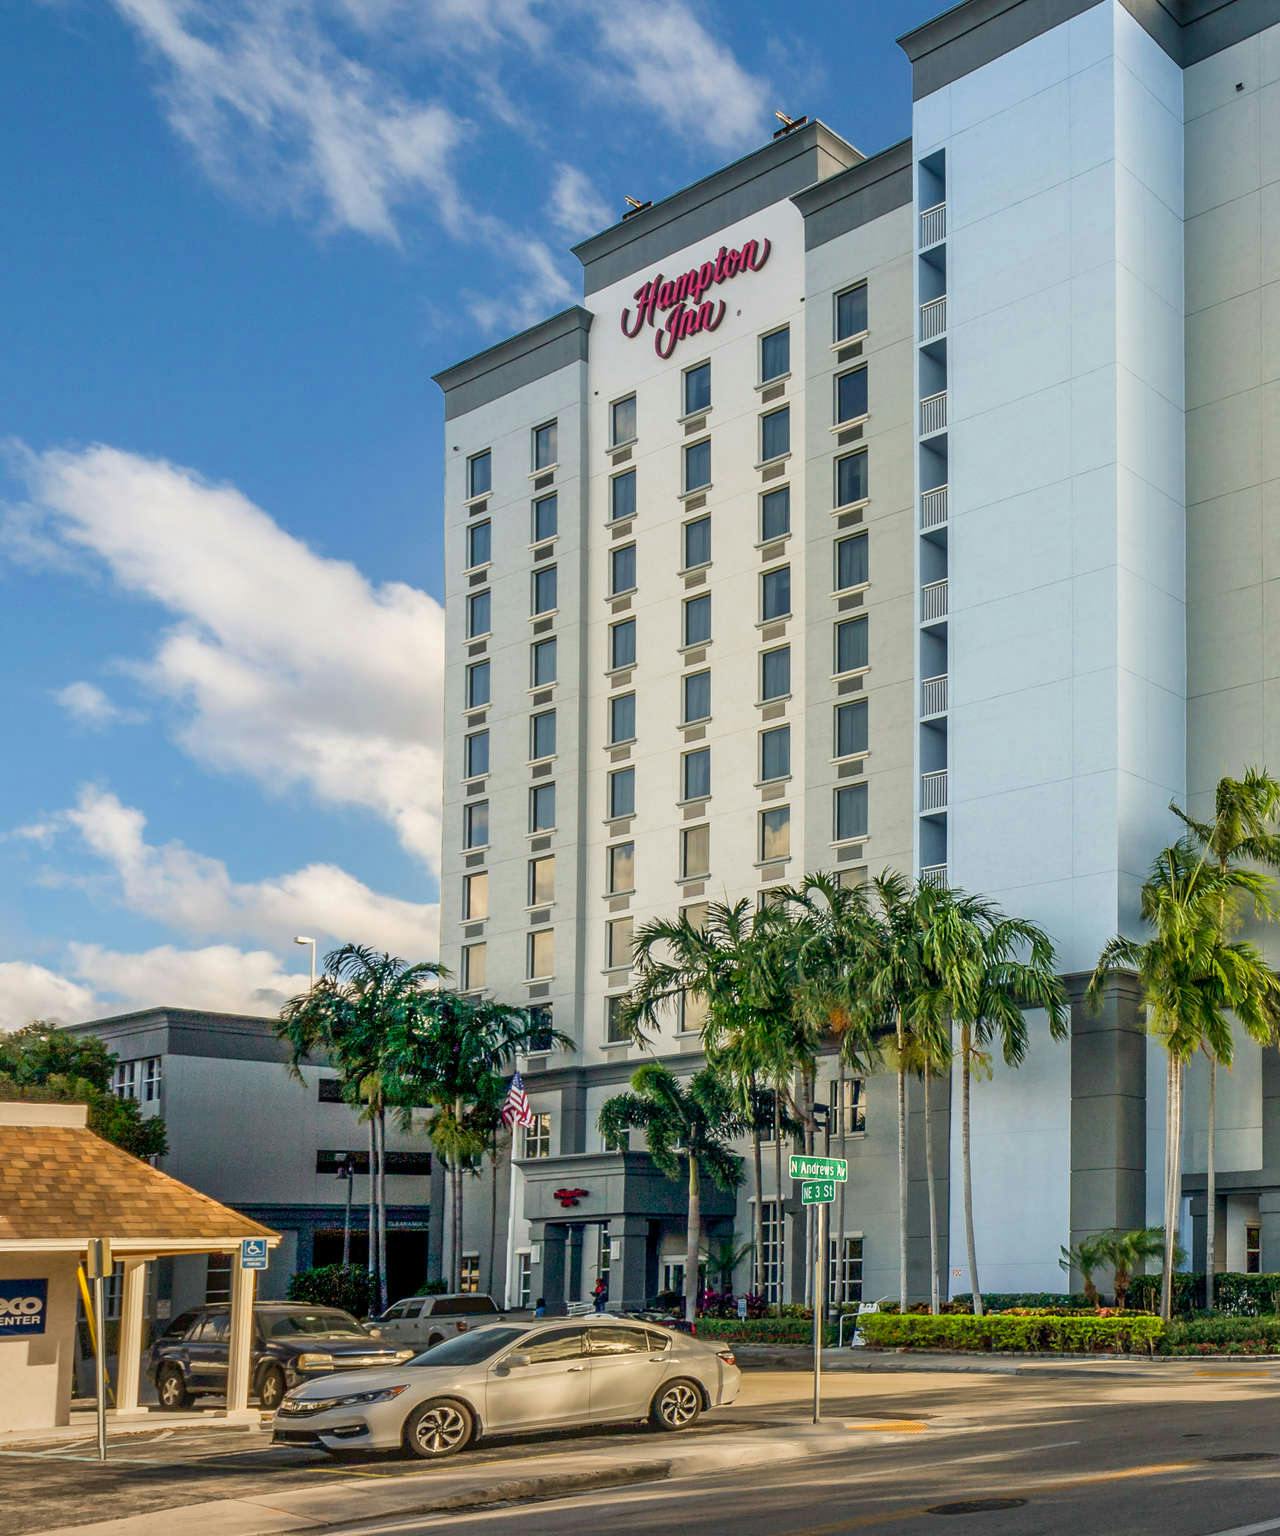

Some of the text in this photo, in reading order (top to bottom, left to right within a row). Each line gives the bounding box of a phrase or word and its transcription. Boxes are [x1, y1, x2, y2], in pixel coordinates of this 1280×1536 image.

[621, 238, 771, 338] Hampton
[655, 300, 726, 359] Inn
[791, 1161, 845, 1177] N Andrews Av
[804, 1185, 832, 1200] NE 3 St
